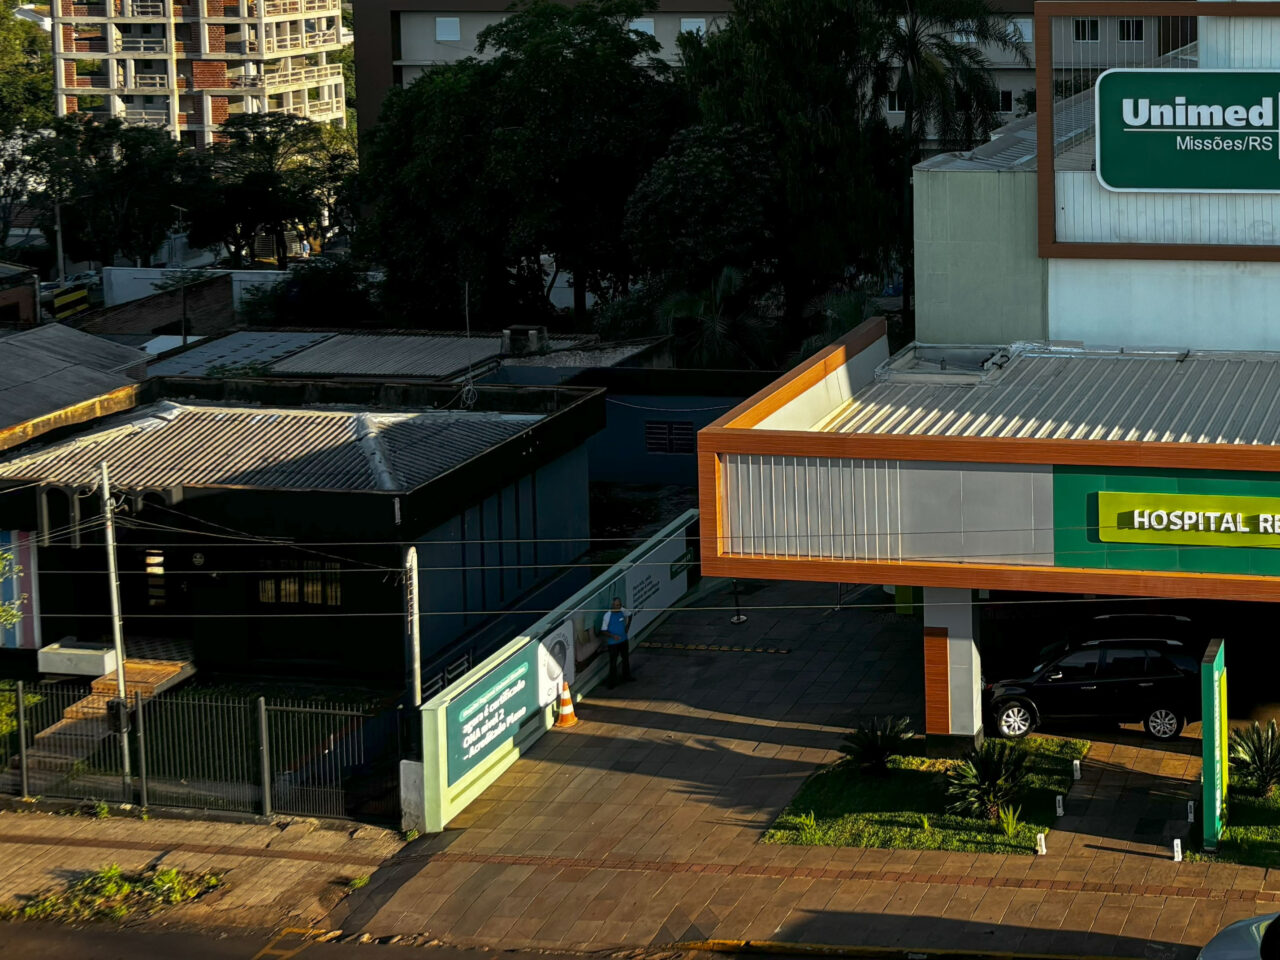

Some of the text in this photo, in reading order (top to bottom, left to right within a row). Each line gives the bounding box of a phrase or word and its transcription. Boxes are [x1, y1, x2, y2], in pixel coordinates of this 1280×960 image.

[1122, 96, 1273, 127] Unimed
[1176, 135, 1273, 151] Missões/RS
[1133, 509, 1250, 533] HOSPITAL
